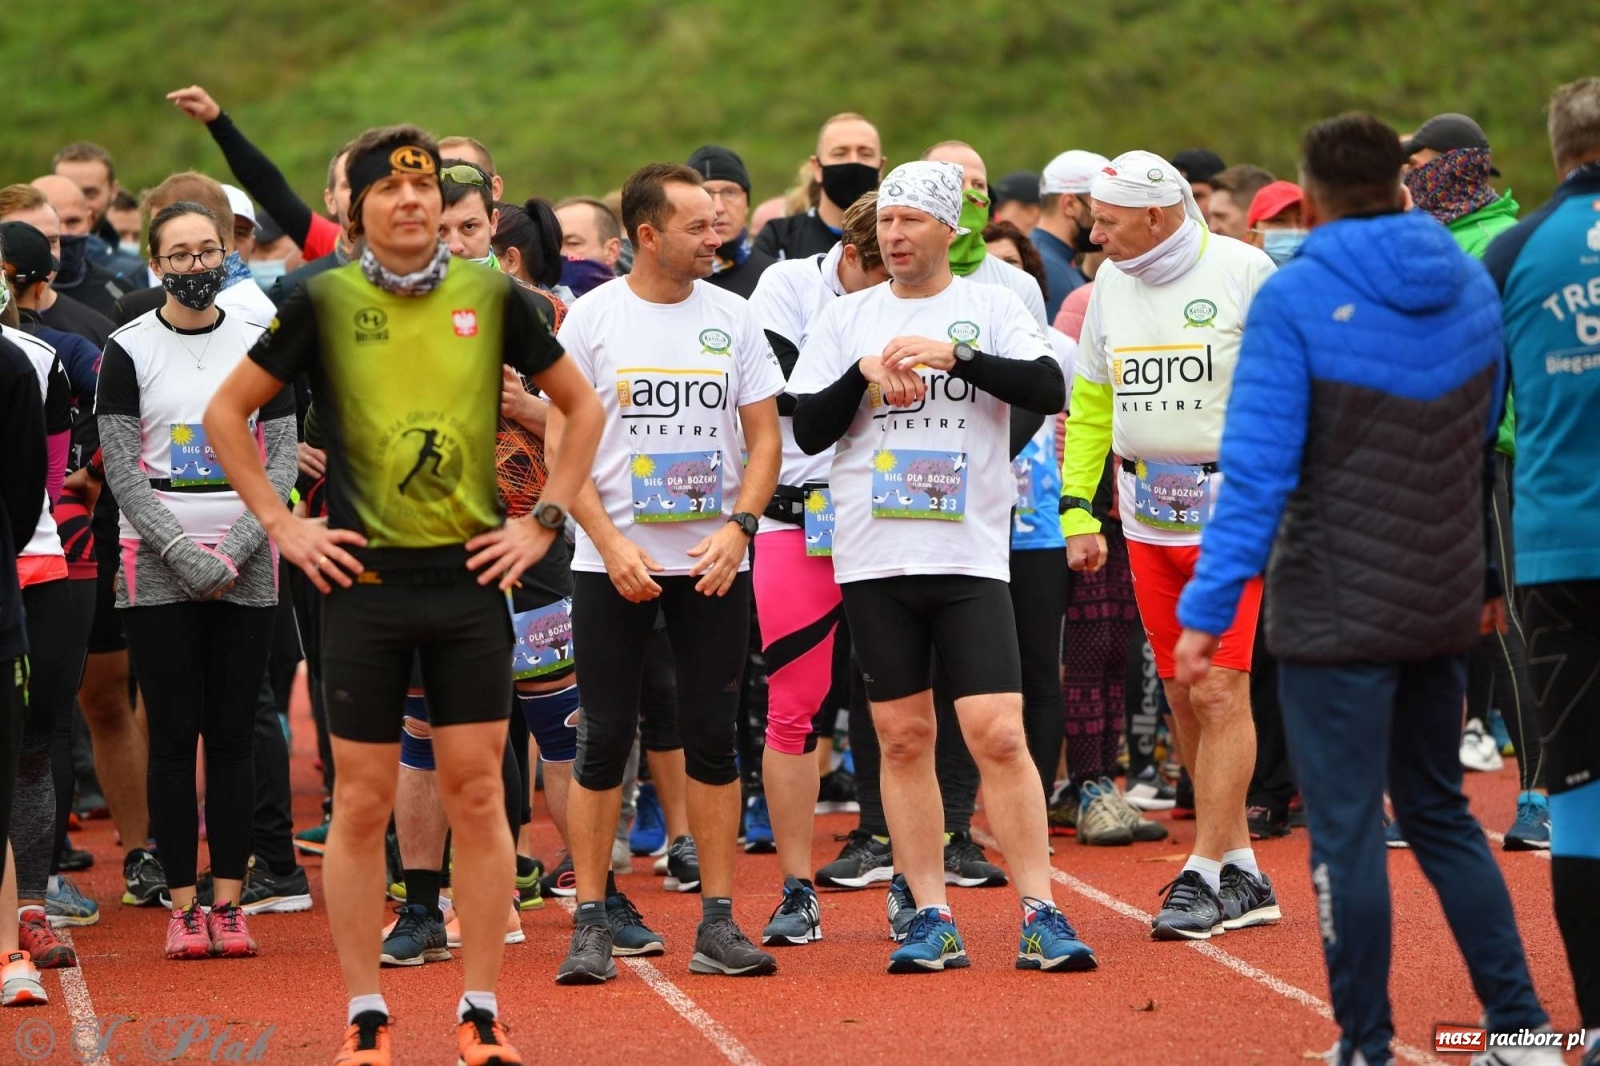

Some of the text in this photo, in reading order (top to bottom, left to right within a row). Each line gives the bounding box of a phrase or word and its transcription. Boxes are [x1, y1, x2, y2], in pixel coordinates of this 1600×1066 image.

[1118, 344, 1213, 396] agrol
[629, 372, 729, 418] agrol
[1122, 399, 1203, 412] KIETRZ
[629, 424, 718, 438] KIETRZ
[182, 445, 216, 454] BIEG DL
[644, 477, 663, 487] BIEG
[667, 476, 683, 486] DLA
[884, 473, 902, 482] BIEG
[907, 473, 923, 482] DLA
[1154, 486, 1167, 496] DLA
[689, 497, 715, 513] 273
[929, 496, 957, 511] 233
[816, 513, 835, 522] BIEG
[1168, 509, 1200, 523] 255
[528, 632, 544, 643] DLA
[1132, 642, 1158, 755] ellesse
